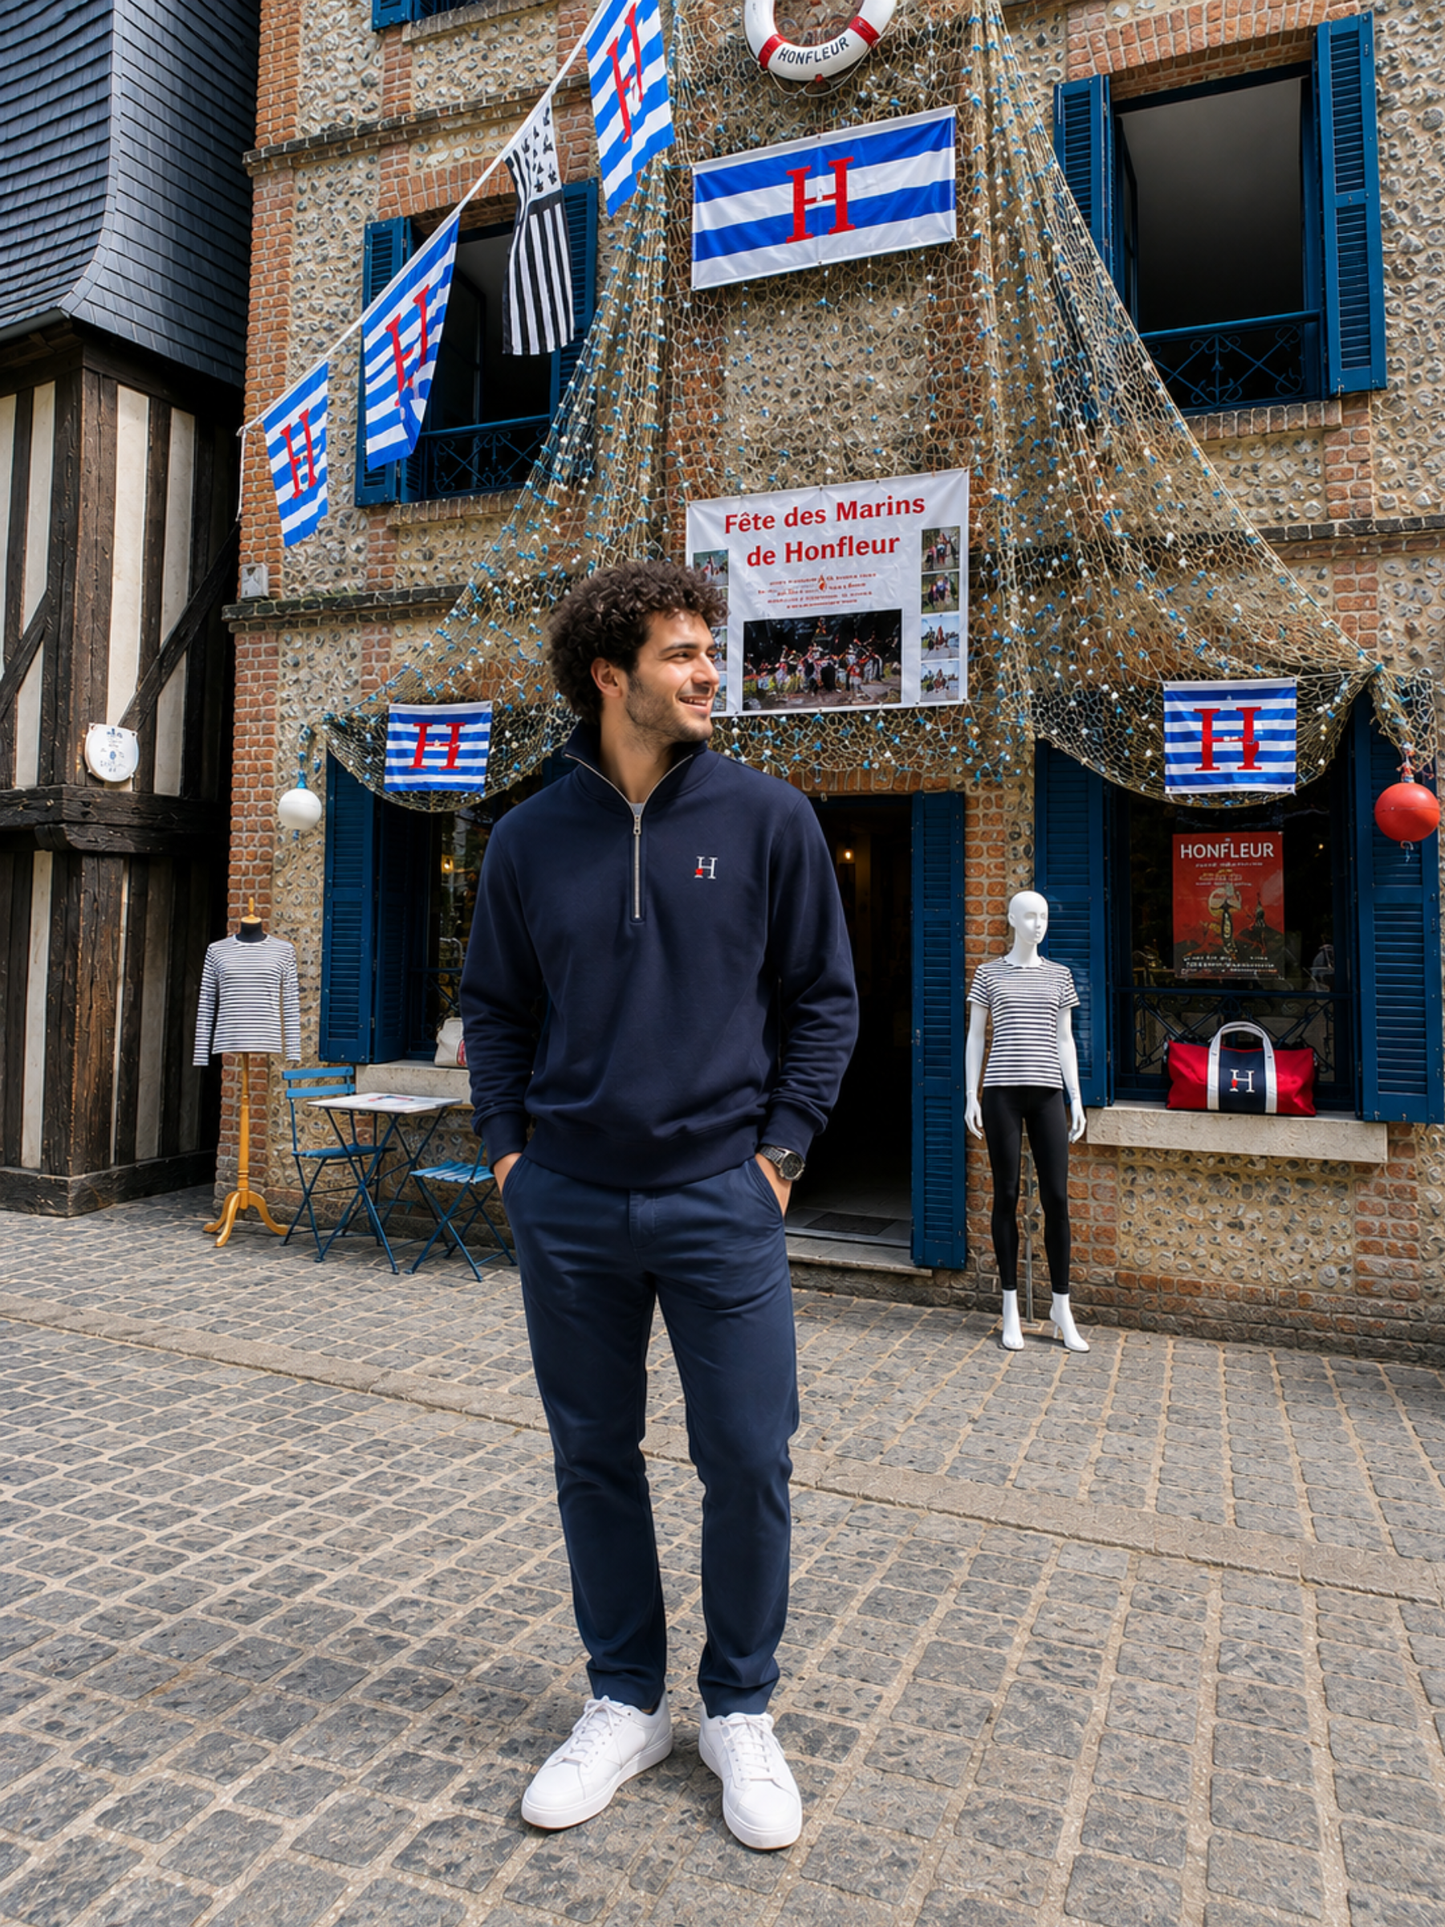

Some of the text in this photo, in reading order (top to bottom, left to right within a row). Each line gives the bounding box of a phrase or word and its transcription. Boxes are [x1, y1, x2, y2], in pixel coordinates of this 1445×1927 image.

[777, 36, 850, 65] HONFLEUR
[786, 156, 856, 244] H
[280, 408, 318, 499] H
[724, 495, 926, 534] Fête des Marins
[746, 535, 901, 567] de Honfleur
[409, 722, 466, 770] H
[1193, 706, 1262, 771] H
[694, 855, 718, 880] H
[1180, 842, 1275, 859] HONFLEUR
[1229, 1068, 1256, 1093] H
